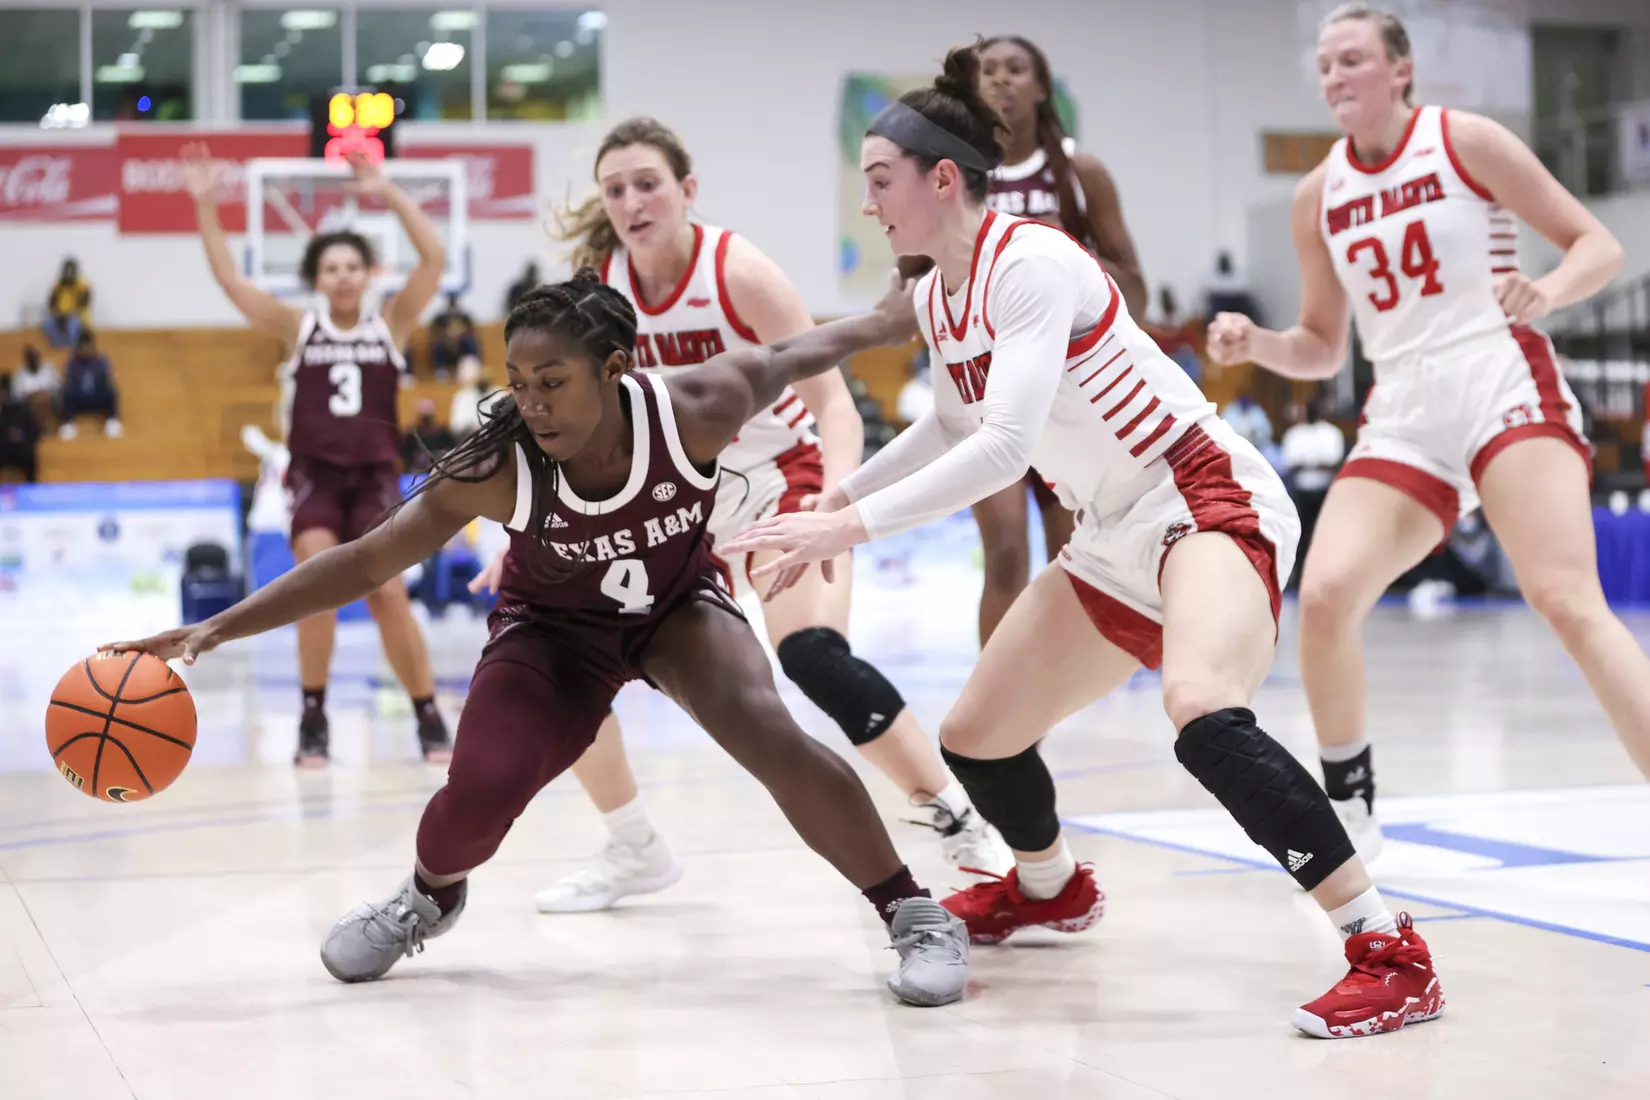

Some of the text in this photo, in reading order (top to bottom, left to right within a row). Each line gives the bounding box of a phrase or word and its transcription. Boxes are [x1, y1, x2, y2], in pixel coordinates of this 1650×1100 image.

[1347, 219, 1444, 312] 34
[328, 362, 362, 417] 3
[653, 483, 676, 500] SEC
[545, 501, 703, 562] EXAS A&M
[600, 559, 655, 614] 4
[1290, 852, 1314, 872] adidas
